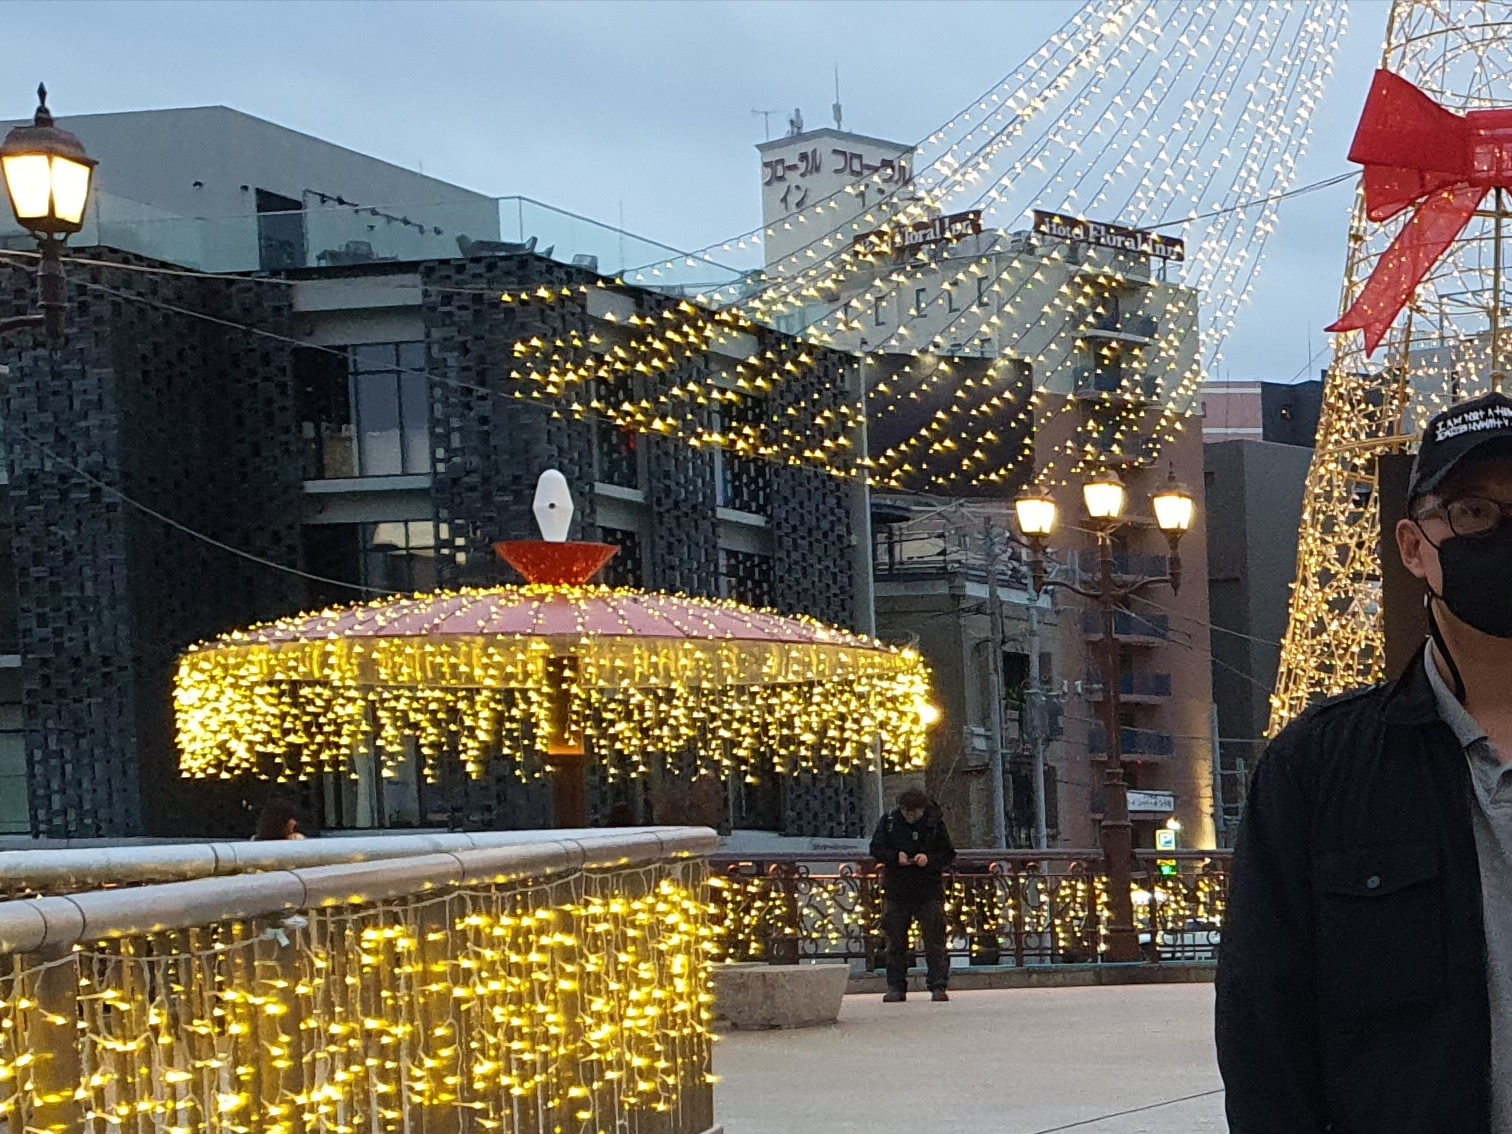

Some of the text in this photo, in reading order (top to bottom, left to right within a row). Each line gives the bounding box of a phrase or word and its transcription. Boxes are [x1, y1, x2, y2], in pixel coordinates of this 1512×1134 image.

[763, 147, 822, 186] フローラル
[780, 184, 808, 211] イン
[1041, 217, 1084, 240] Hotel
[1088, 222, 1142, 252] Floral
